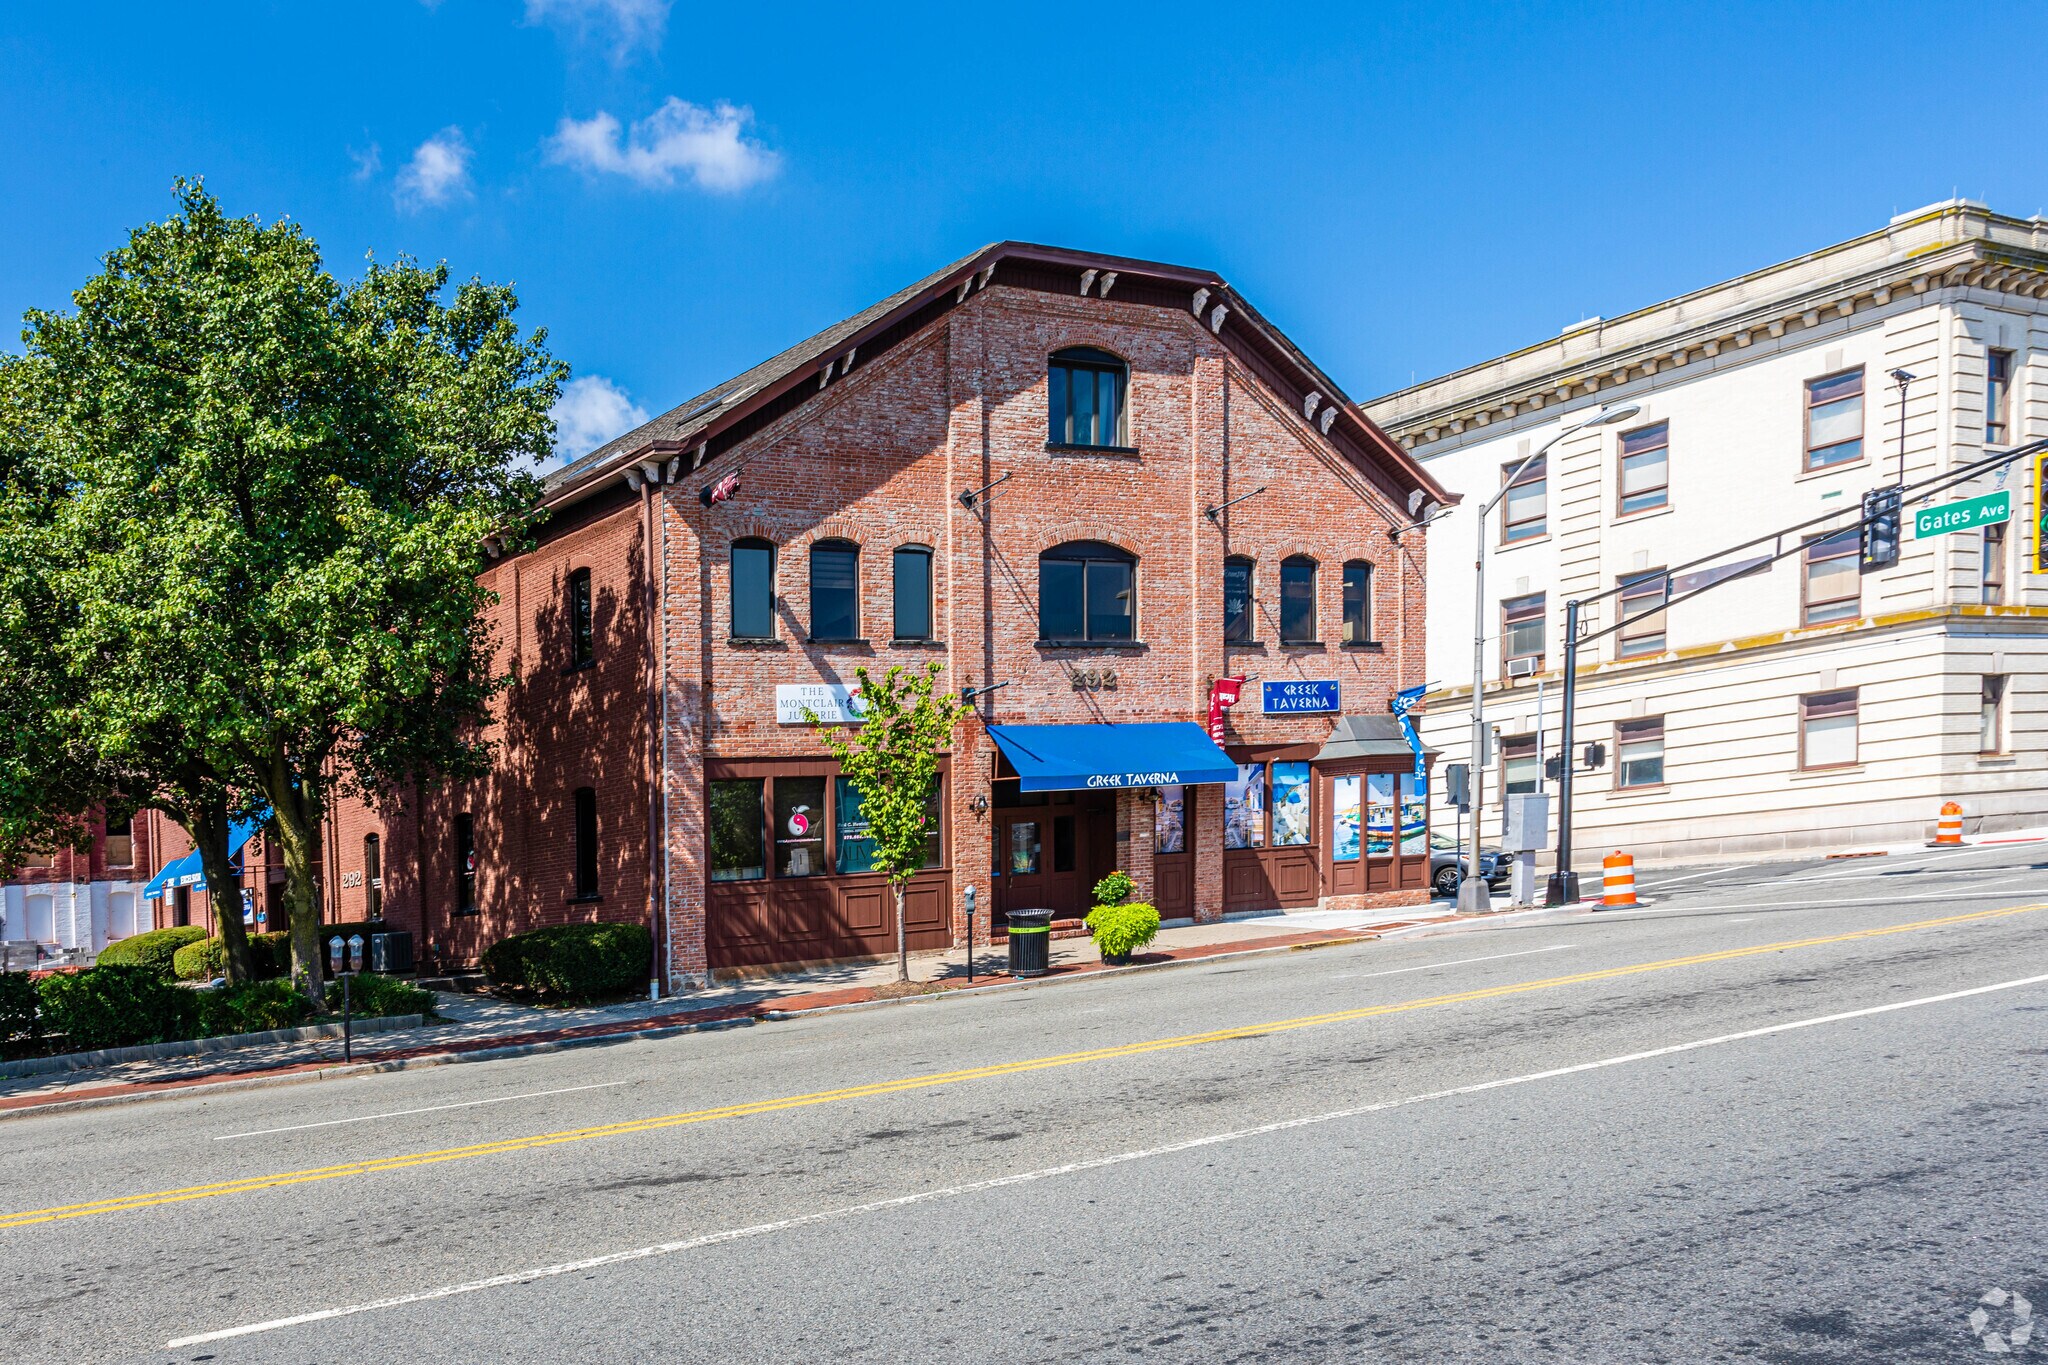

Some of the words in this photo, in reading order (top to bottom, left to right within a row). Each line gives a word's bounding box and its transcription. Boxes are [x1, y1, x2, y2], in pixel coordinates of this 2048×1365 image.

[1919, 509, 1971, 532] Gates
[1978, 504, 2006, 519] Ave
[1070, 668, 1116, 688] 292
[800, 687, 825, 696] THE
[1283, 684, 1319, 696] GREEK
[780, 698, 845, 708] MONTCLAIR
[1272, 696, 1330, 710] TAVERNA
[788, 710, 838, 721] JUERIE
[1086, 774, 1122, 788] GREEK
[1125, 771, 1180, 786] TAVERNA
[342, 870, 362, 888] 292
